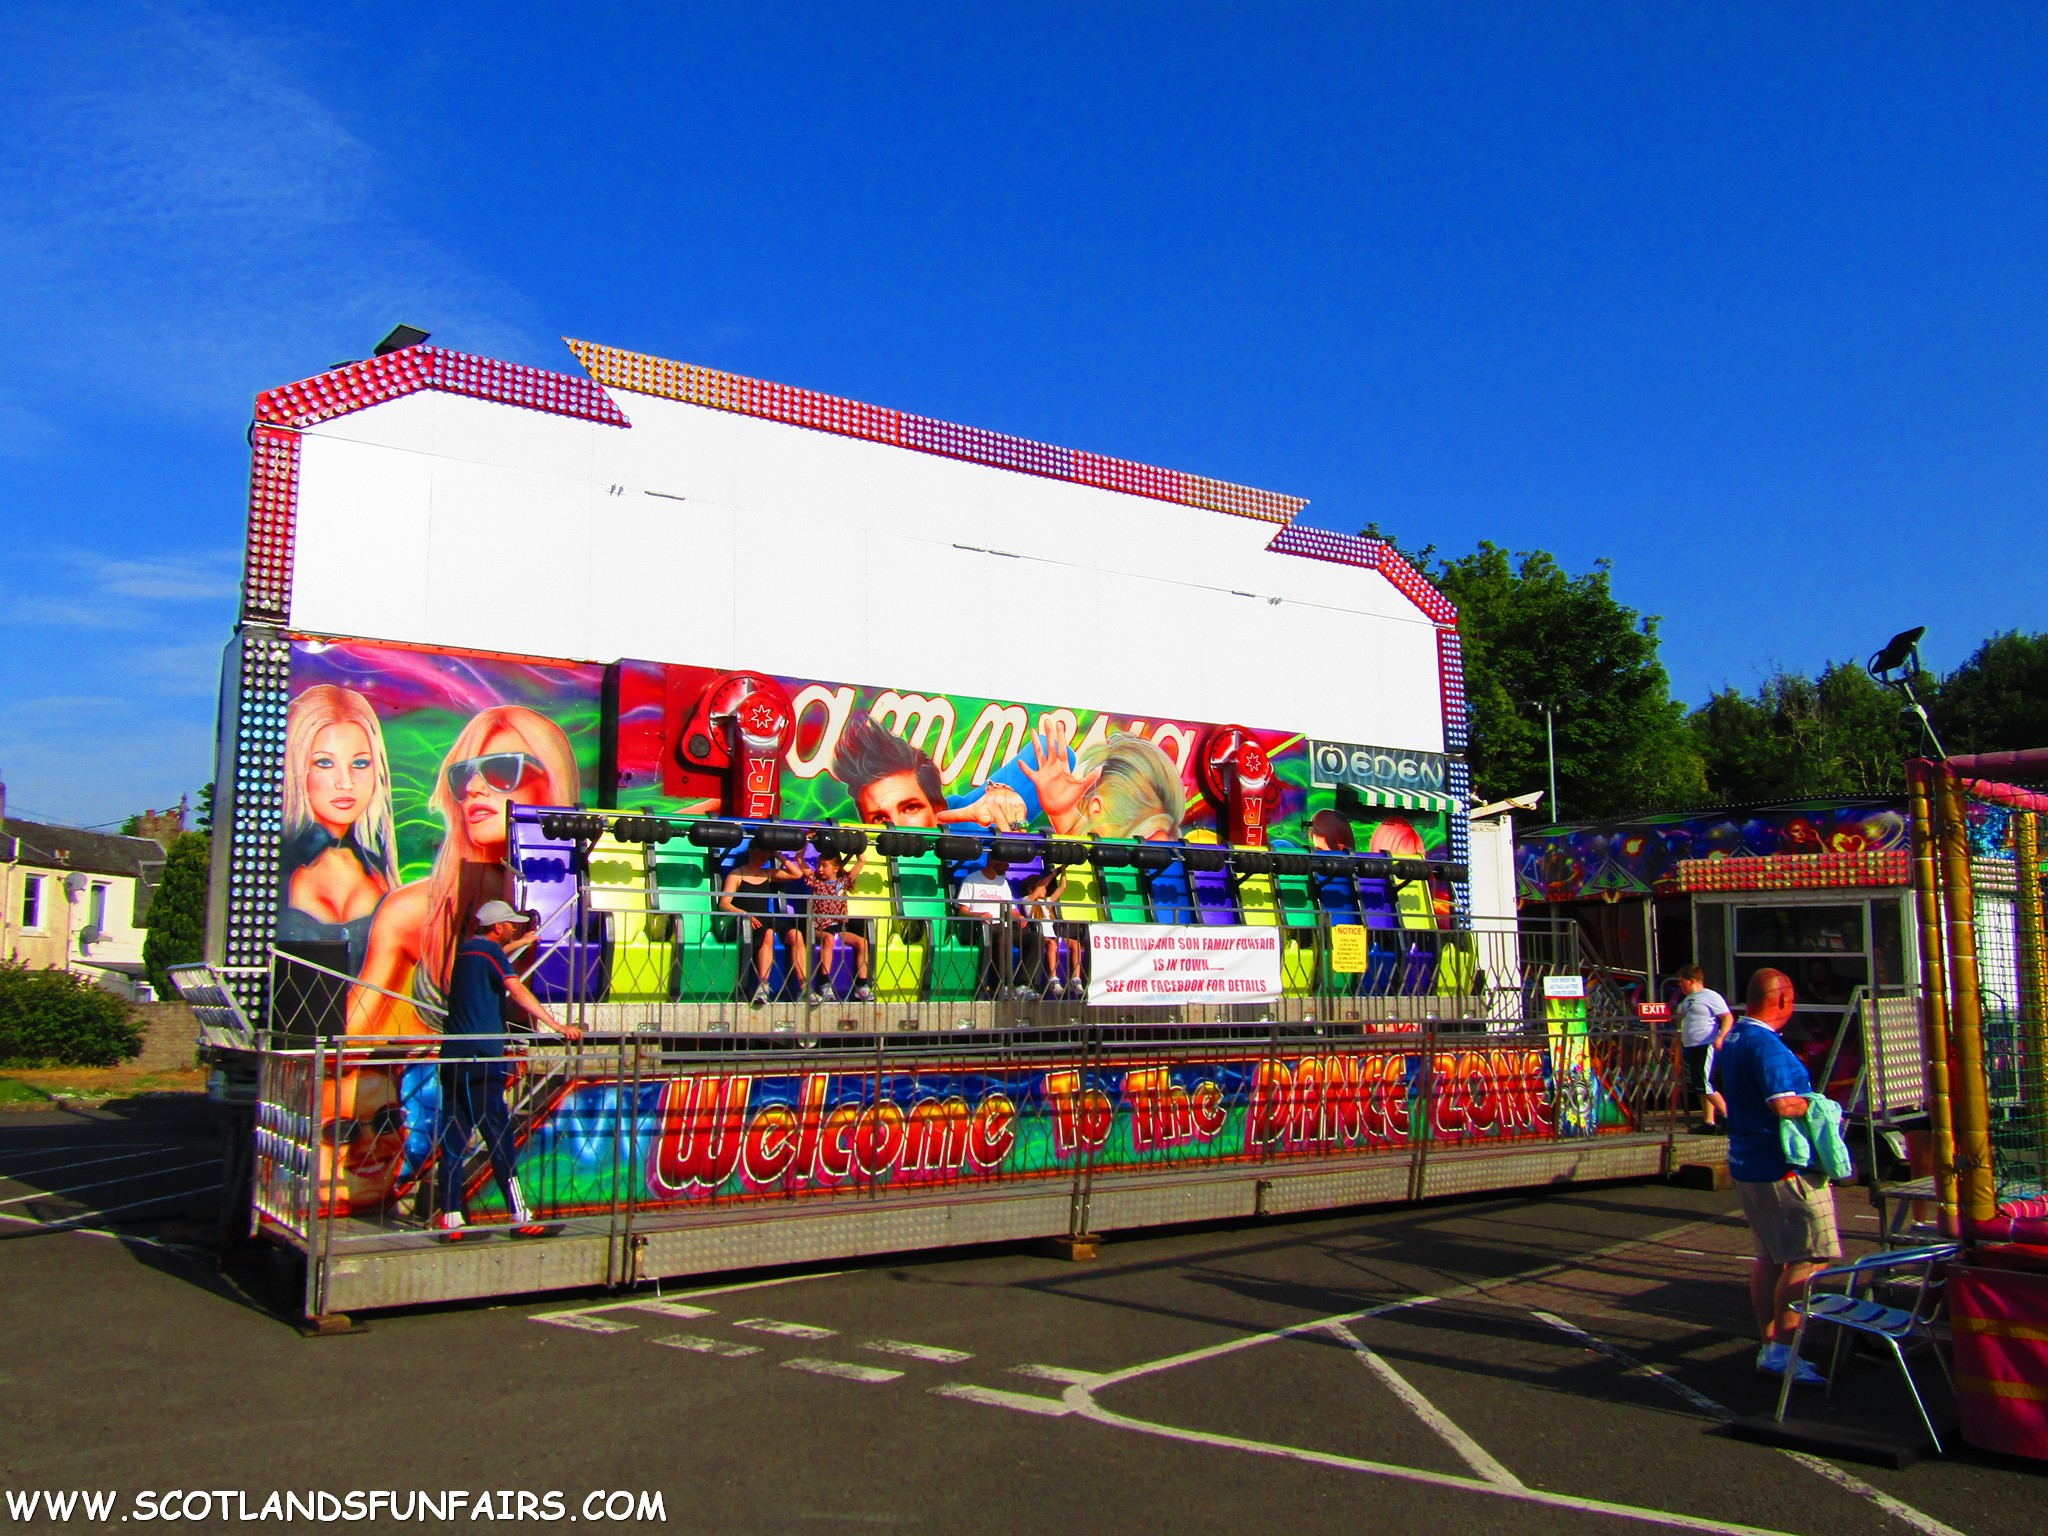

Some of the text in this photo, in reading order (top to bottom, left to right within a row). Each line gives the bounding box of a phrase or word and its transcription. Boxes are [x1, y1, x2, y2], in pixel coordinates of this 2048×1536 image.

[1093, 935, 1101, 949] G
[1178, 937, 1199, 950] SON
[1203, 937, 1235, 950] FAMILY
[1236, 937, 1275, 950] FUNFAIR
[1153, 958, 1164, 971] IS
[1166, 958, 1178, 971] IN
[1105, 979, 1267, 992] SEE OUR FACEBOOK FOR DETAILS
[1642, 1005, 1666, 1014] EXIT
[652, 1072, 1016, 1193] Welcome
